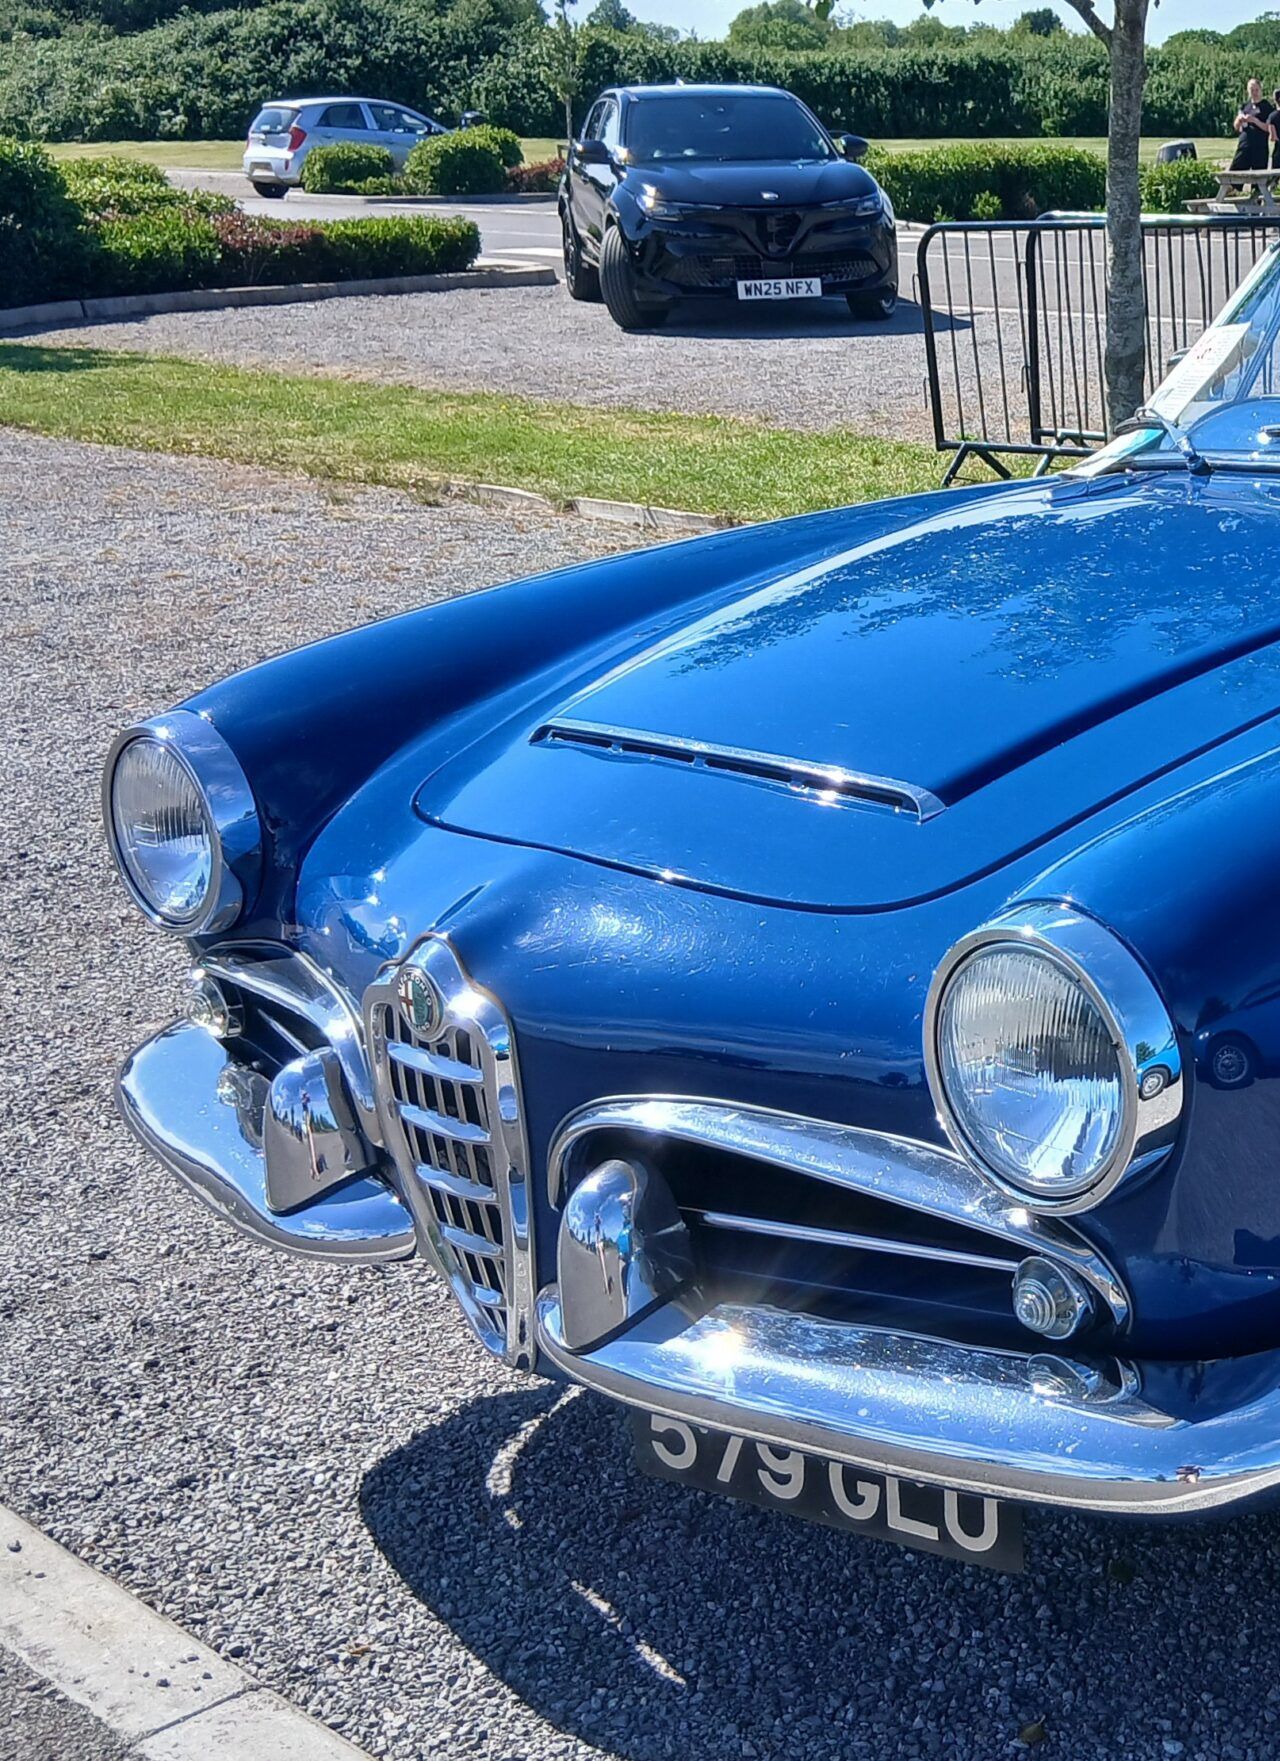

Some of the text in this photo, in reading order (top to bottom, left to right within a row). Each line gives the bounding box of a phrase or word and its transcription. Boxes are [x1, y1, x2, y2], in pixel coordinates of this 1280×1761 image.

[744, 281, 814, 296] WN25 NFX
[650, 1413, 805, 1500] 579
